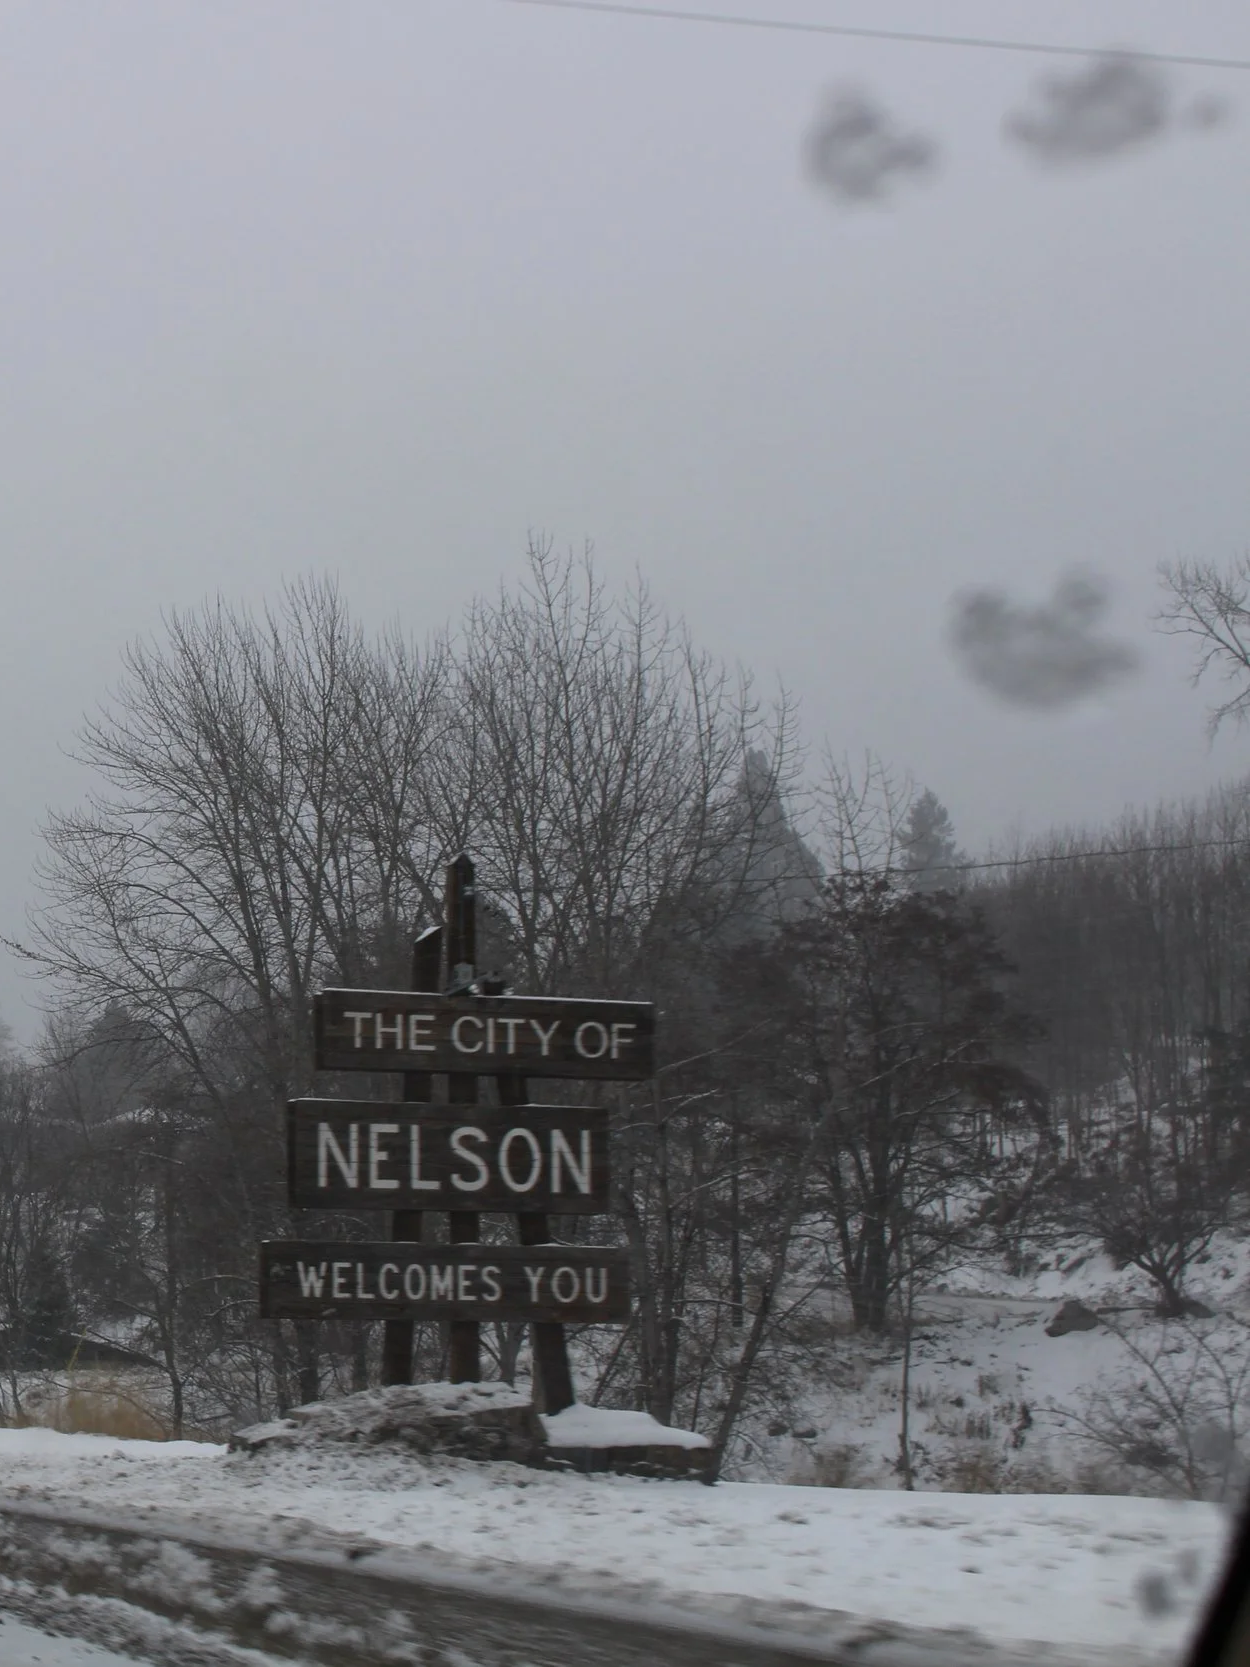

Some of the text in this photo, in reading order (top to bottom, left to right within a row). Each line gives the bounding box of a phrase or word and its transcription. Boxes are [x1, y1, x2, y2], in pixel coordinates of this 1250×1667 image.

[343, 1011, 637, 1060] THE CITY OF
[317, 1122, 591, 1195] NELSON
[296, 1261, 608, 1303] WELCOMES YOU
